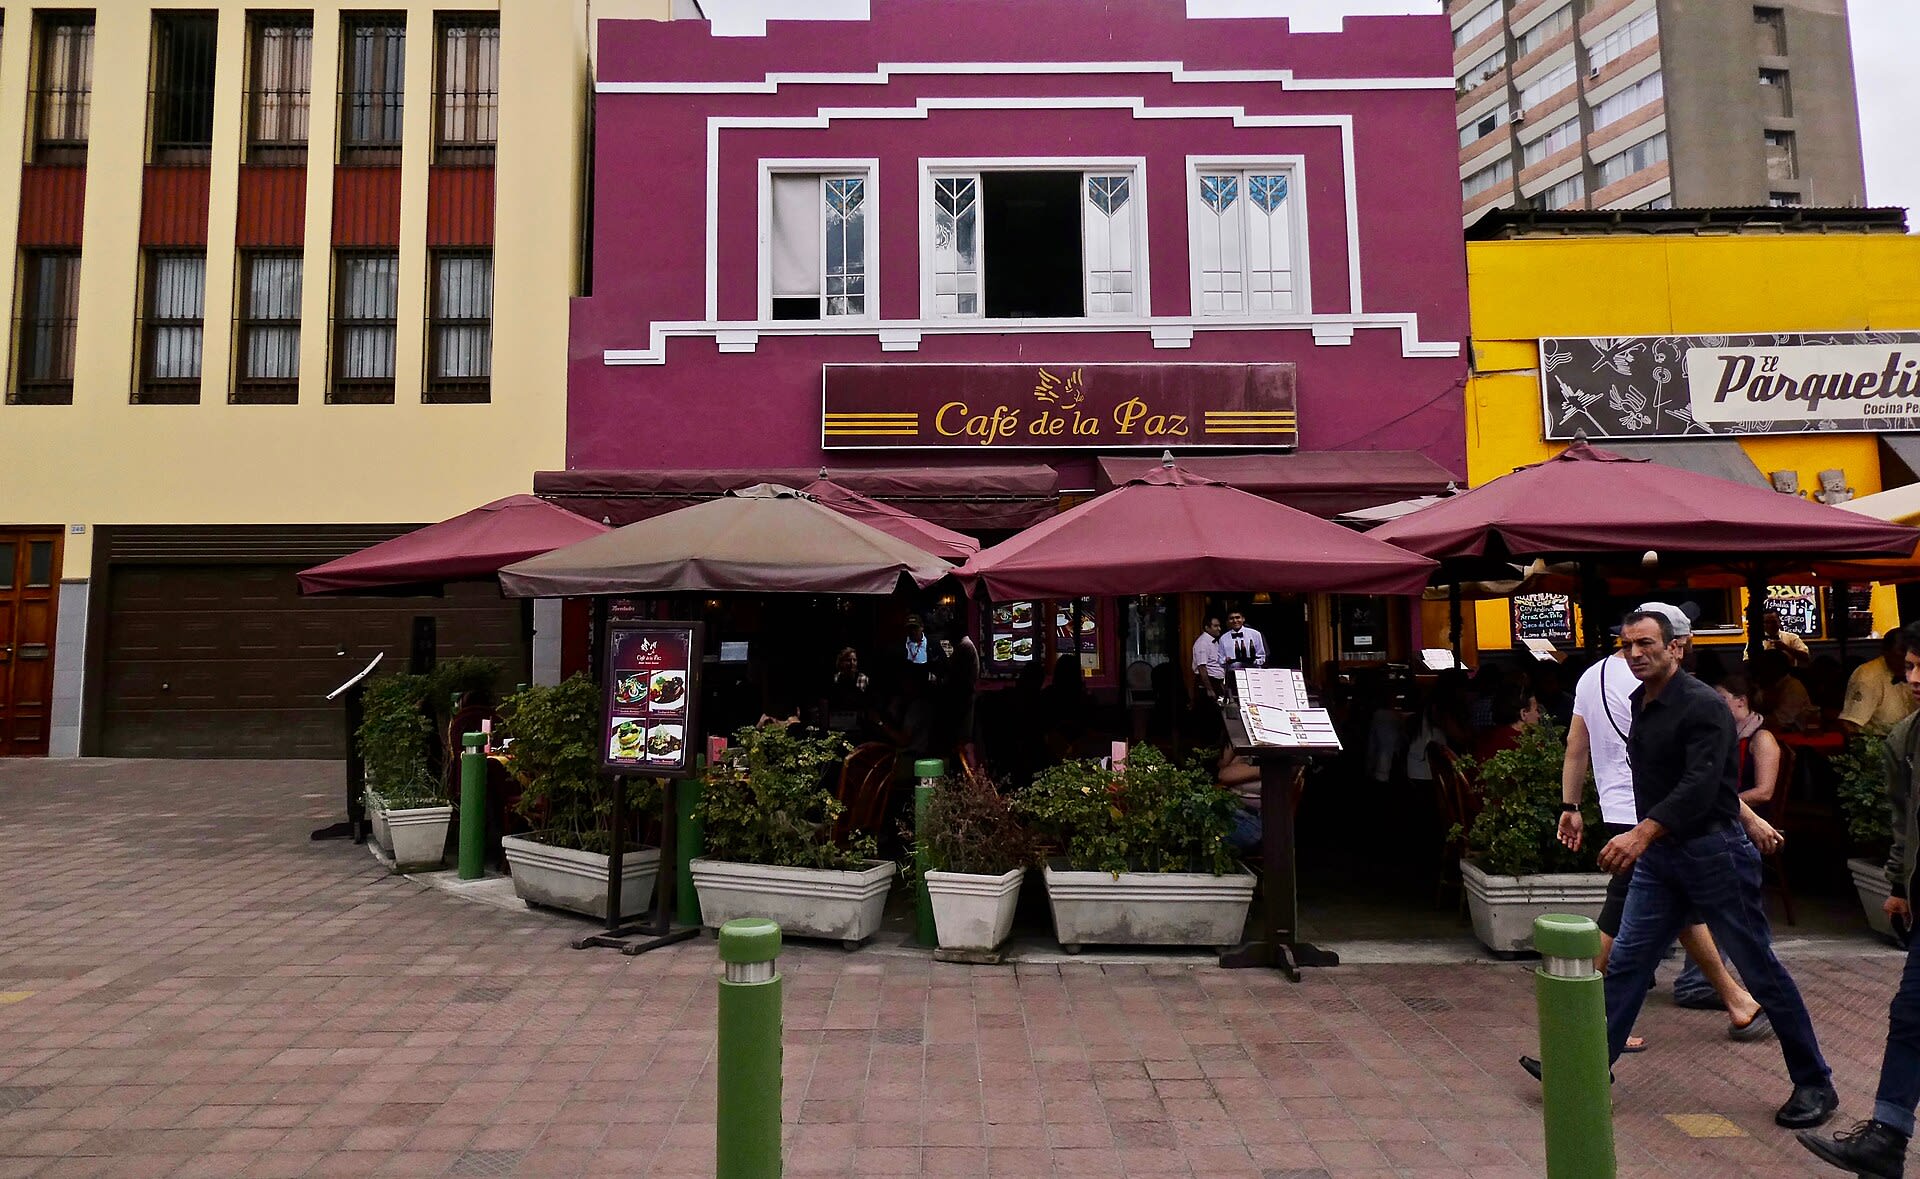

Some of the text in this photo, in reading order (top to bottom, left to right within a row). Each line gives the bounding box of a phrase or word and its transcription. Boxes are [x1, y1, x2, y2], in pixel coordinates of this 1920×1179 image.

[1760, 355, 1779, 372] El
[1863, 402, 1920, 415] Cocina Pe
[935, 396, 1189, 445] Café de la Paz
